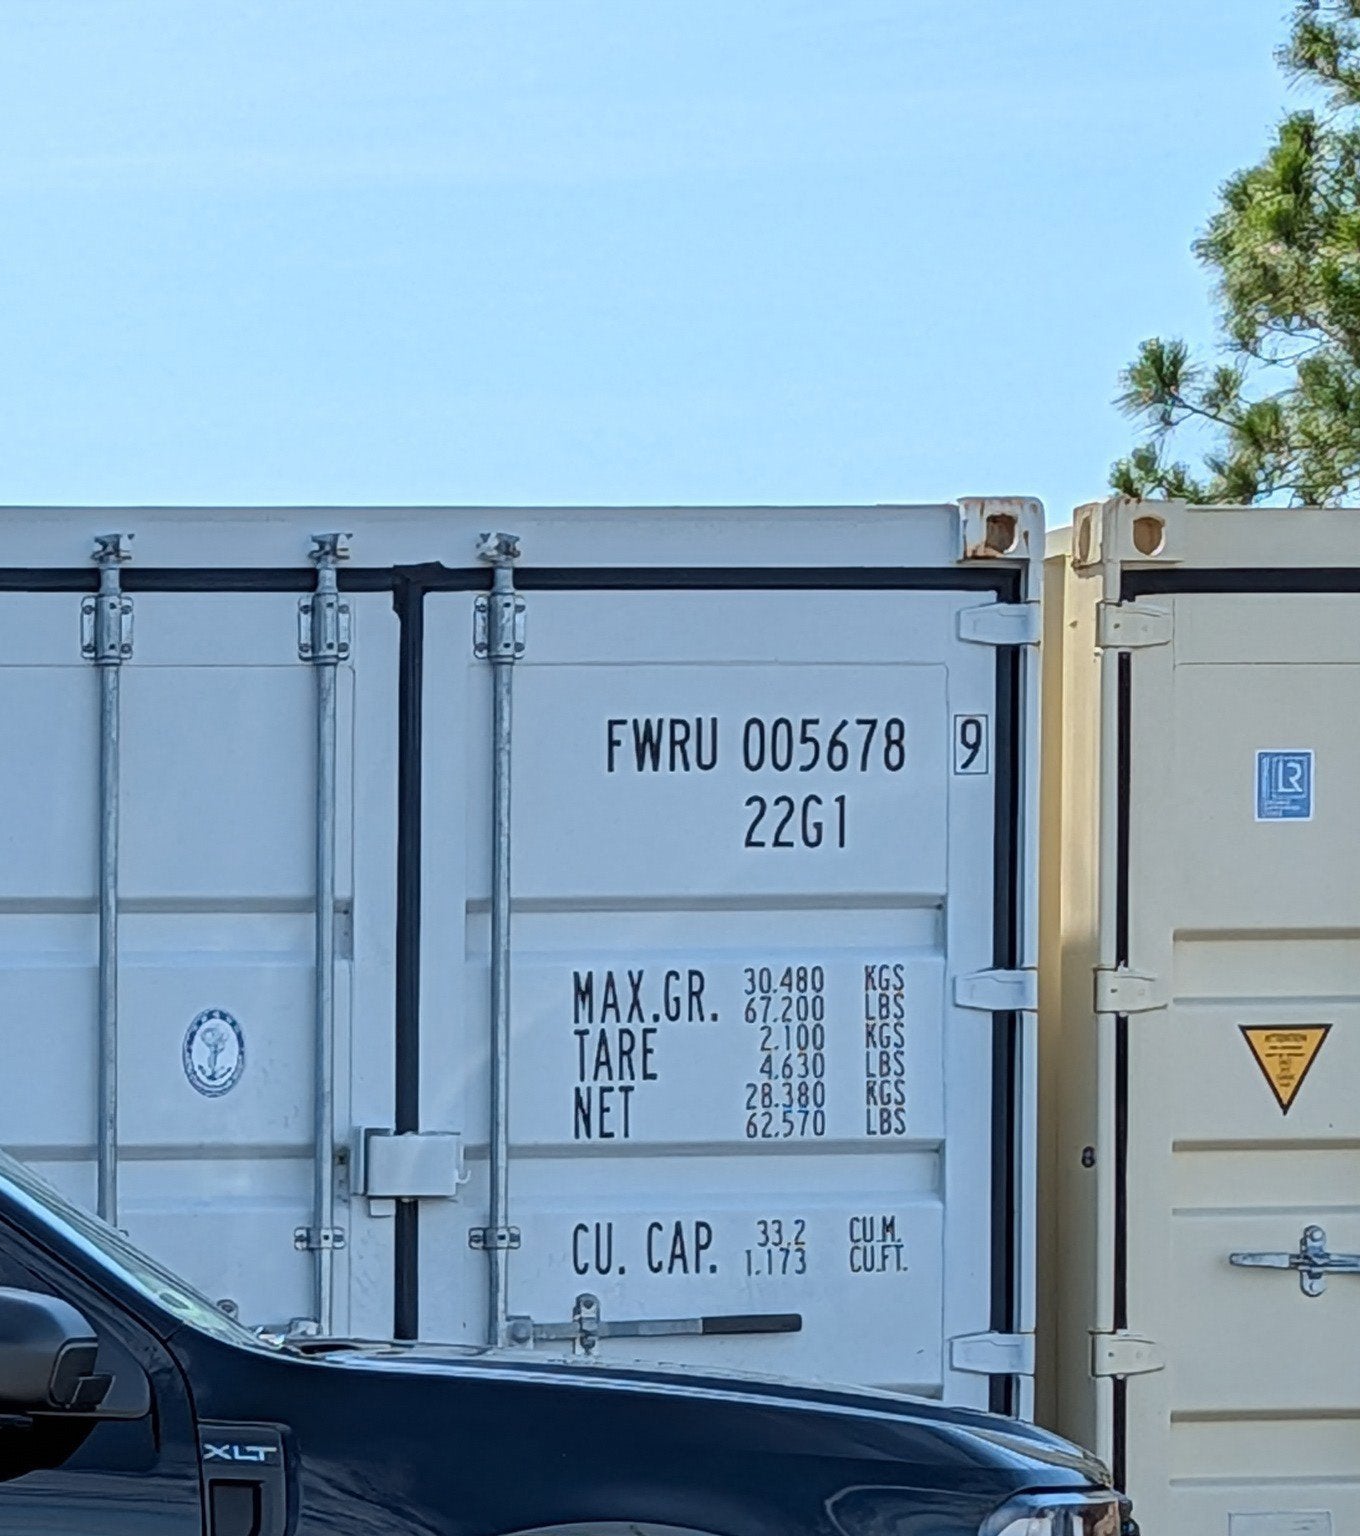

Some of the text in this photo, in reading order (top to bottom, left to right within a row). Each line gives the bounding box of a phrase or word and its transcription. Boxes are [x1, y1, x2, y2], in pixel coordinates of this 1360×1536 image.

[607, 717, 982, 772] FWRU 005678 9
[744, 794, 846, 848] 22G1
[744, 964, 905, 995] 30.480 KGS
[744, 993, 905, 1023] 67.200 LBS
[760, 1022, 905, 1051] 2.100 KGS
[574, 1028, 658, 1082] TARE
[759, 1051, 905, 1080] 4.630 LBS
[746, 1079, 906, 1109] 28.380 KGS
[574, 1086, 635, 1139] NET
[746, 1108, 906, 1138] 62.570 LBS
[573, 1220, 717, 1275] CU. CAP.
[757, 1219, 806, 1247] 33.2
[745, 1248, 807, 1276] 1.173
[203, 1444, 277, 1461] XLT
